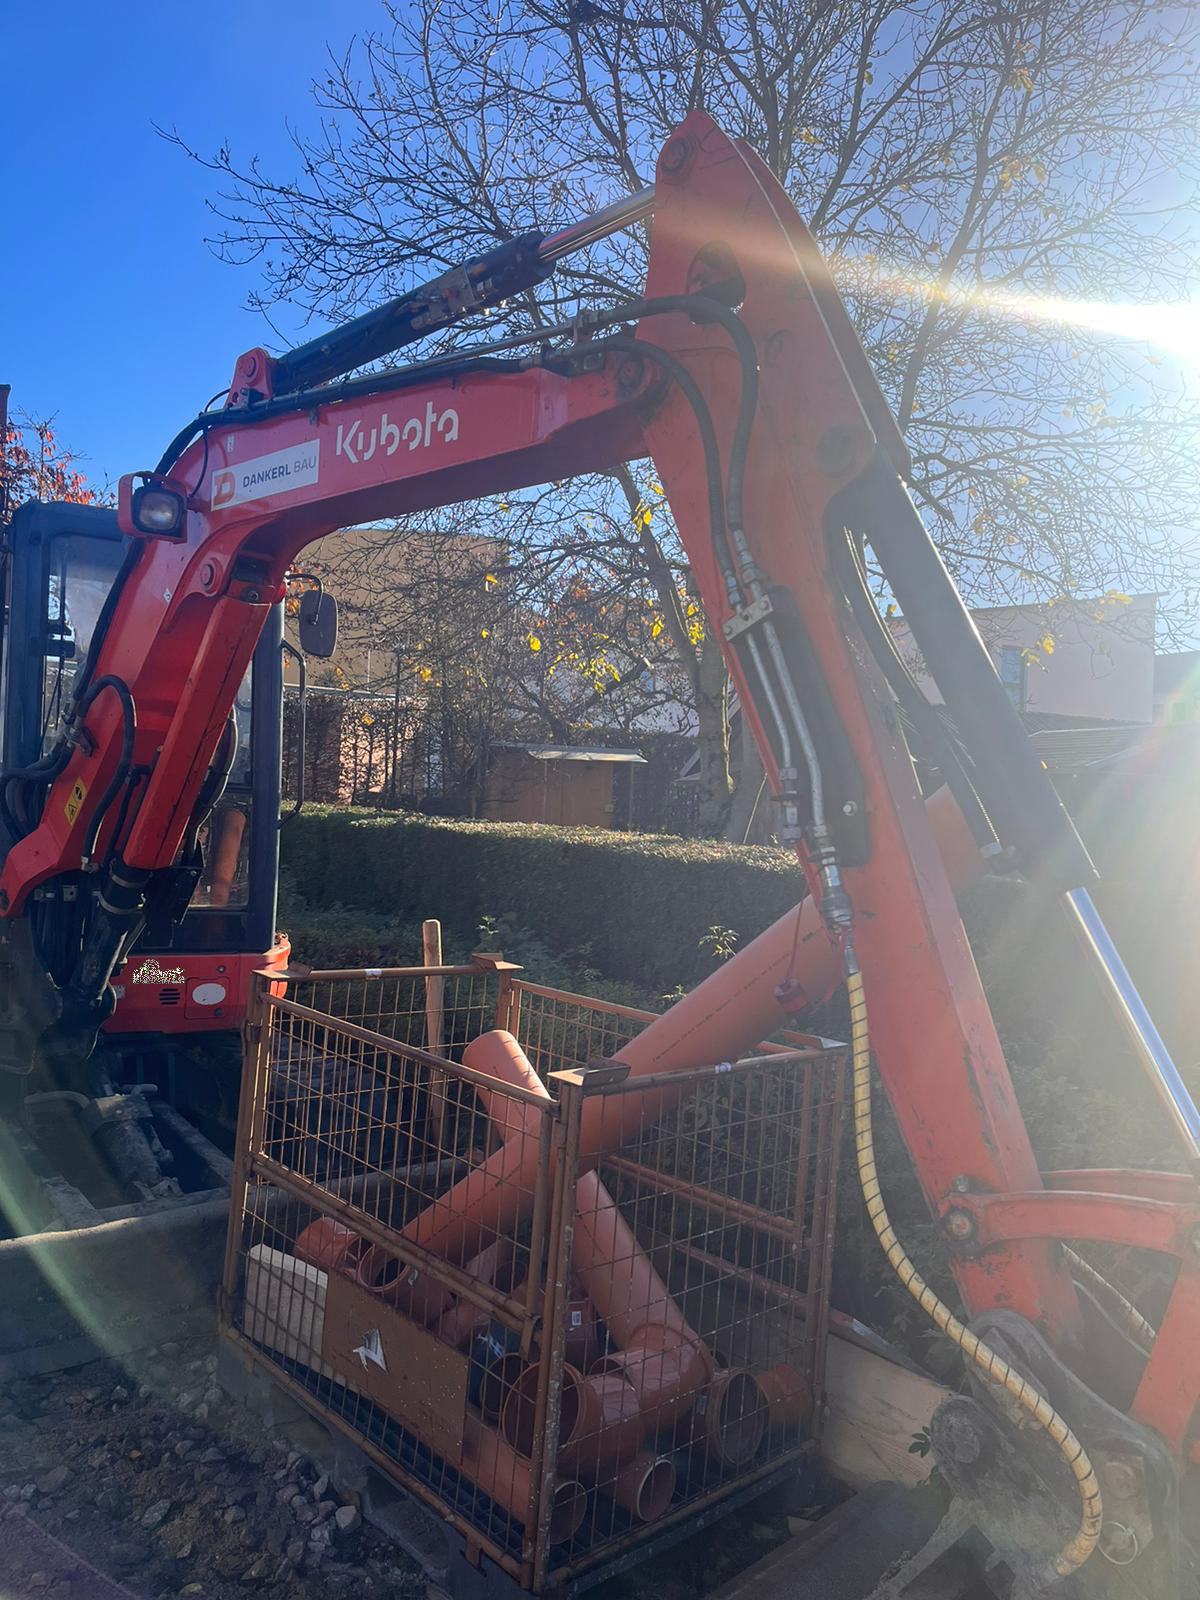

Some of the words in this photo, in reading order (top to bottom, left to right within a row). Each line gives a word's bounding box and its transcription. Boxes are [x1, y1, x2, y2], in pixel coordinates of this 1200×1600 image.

[336, 401, 459, 464] Kubota
[242, 463, 292, 488] DANKERL
[293, 455, 317, 473] BAU
